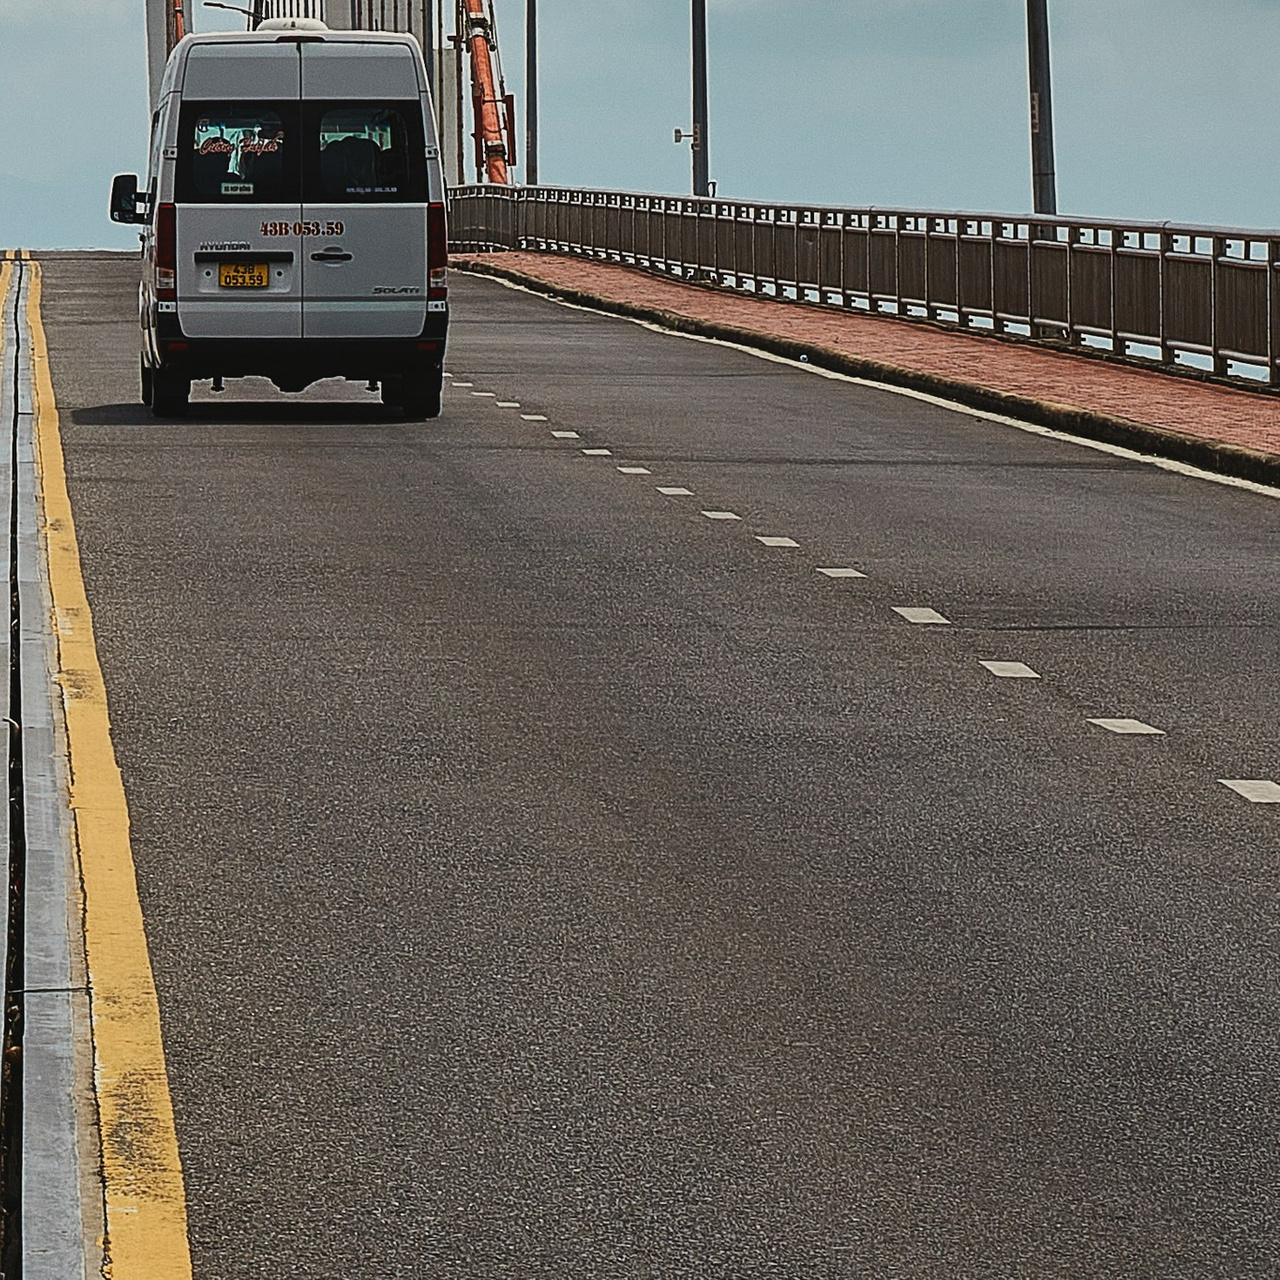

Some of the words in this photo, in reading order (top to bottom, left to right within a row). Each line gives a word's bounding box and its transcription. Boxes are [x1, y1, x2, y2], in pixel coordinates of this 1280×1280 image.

[199, 241, 251, 251] HYUNDAI
[233, 264, 254, 274] 43B
[224, 274, 263, 285] 053.59
[372, 286, 420, 294] SOLATI
